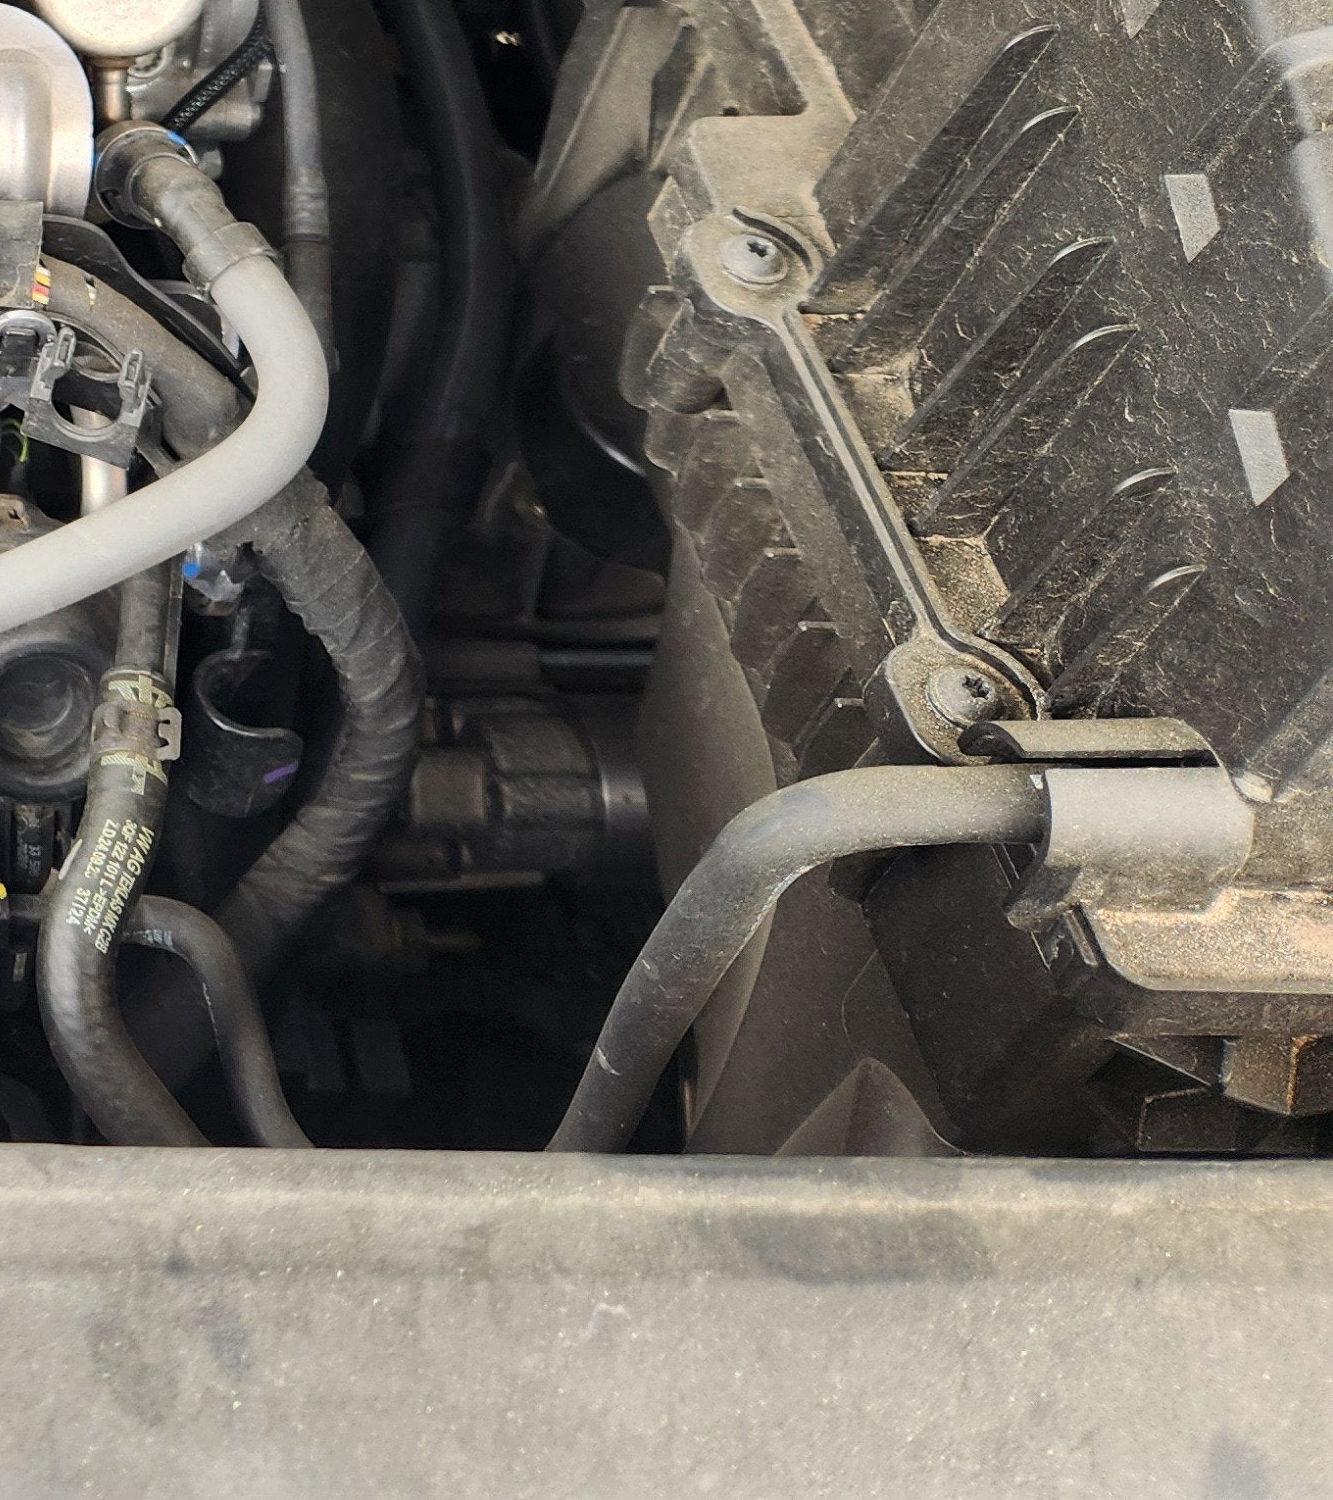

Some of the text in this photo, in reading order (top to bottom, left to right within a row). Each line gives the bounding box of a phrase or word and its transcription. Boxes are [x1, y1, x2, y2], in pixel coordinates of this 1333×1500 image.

[136, 826, 154, 854] VW
[127, 847, 144, 875] AG
[110, 871, 135, 914] TEKLAS
